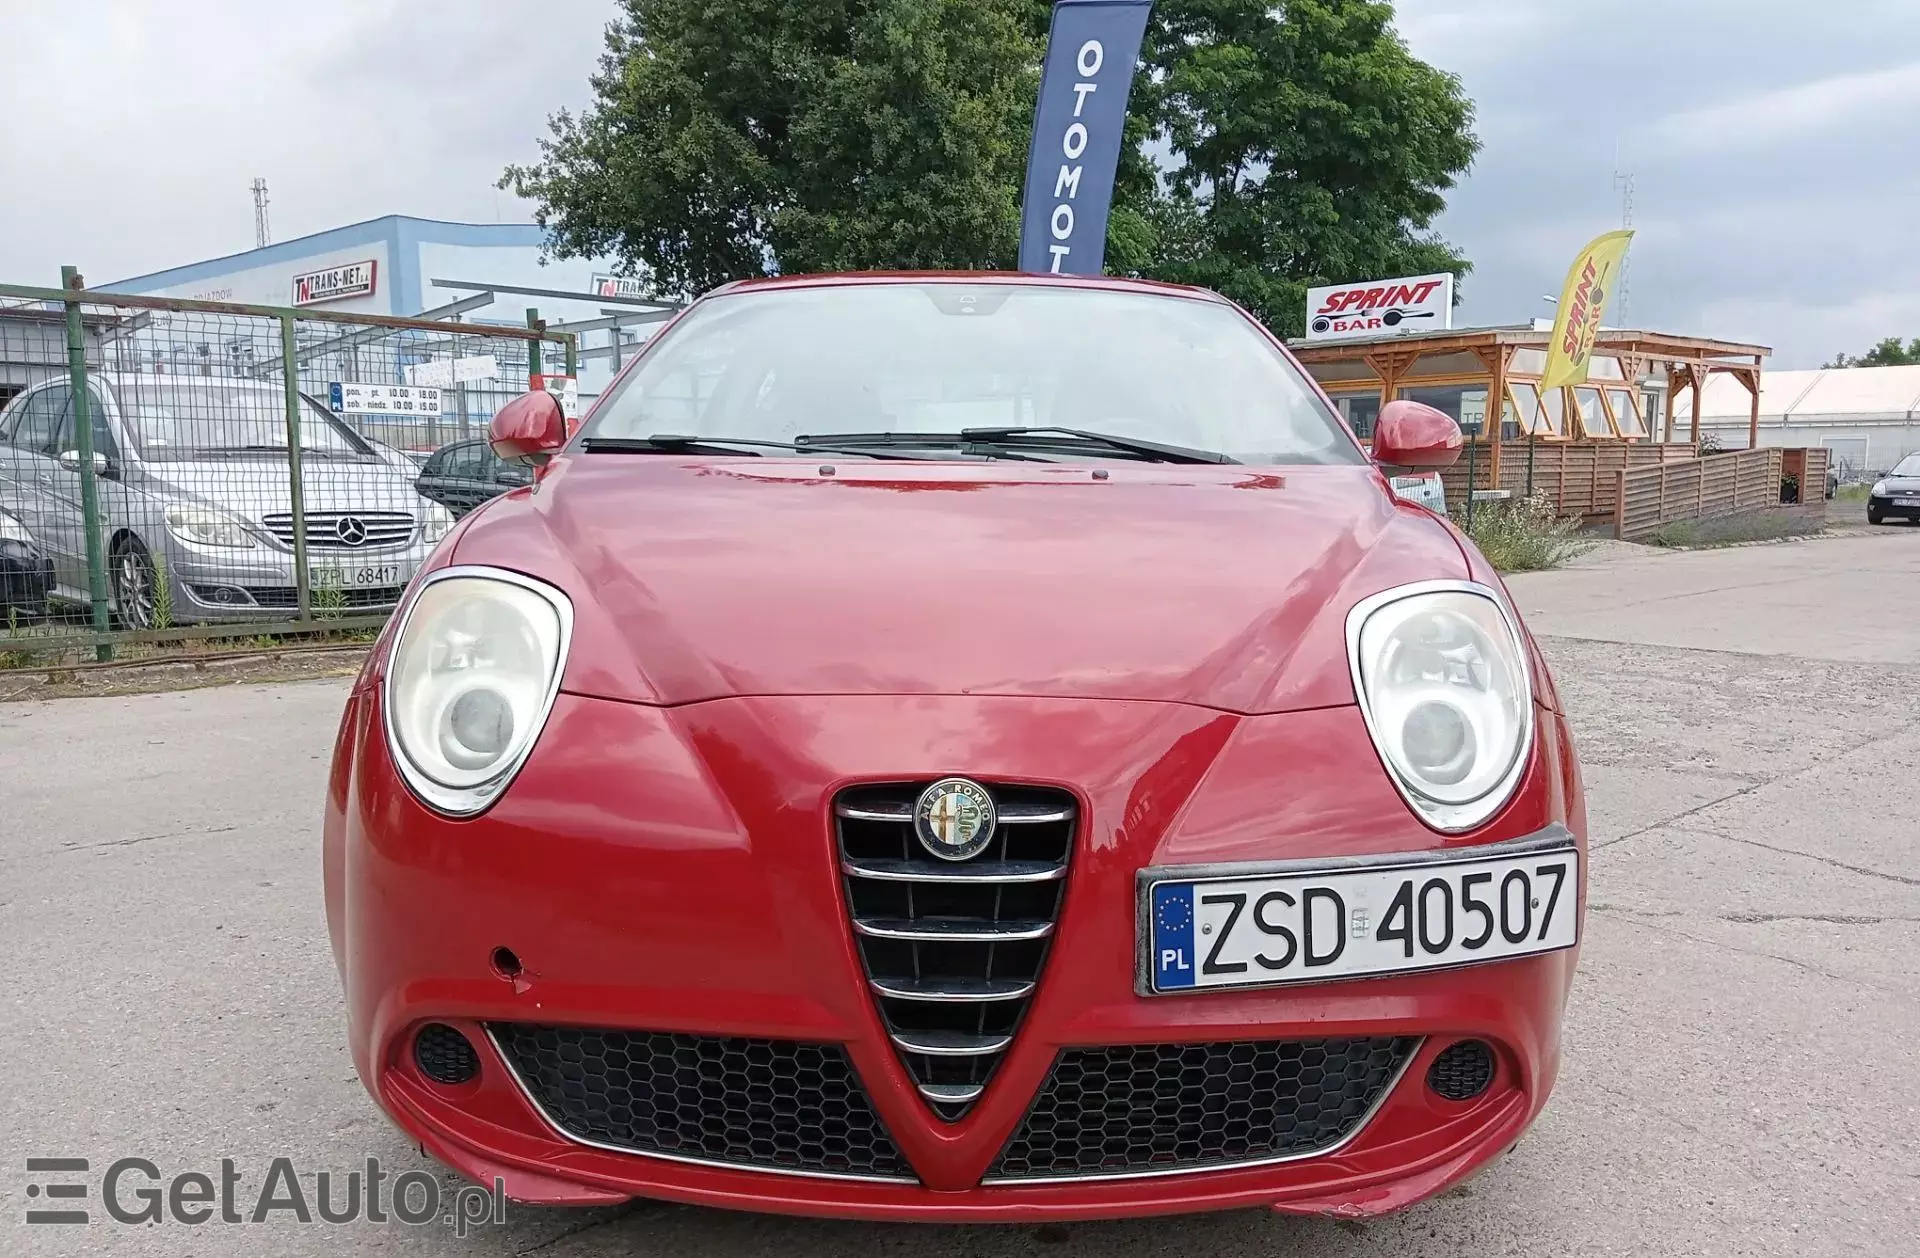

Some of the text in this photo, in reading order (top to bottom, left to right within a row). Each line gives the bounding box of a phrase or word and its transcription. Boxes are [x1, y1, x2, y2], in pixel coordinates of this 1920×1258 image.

[1317, 281, 1443, 314] SPRINT
[1563, 256, 1596, 362] SPRINT
[1333, 318, 1382, 332] BAR
[1584, 306, 1602, 349] BAR
[389, 388, 409, 398] 10.00
[357, 566, 398, 584] 68417
[921, 784, 991, 821] ALFA ROMEO
[1201, 863, 1567, 975] ZSD 40507
[1161, 948, 1190, 972] PL
